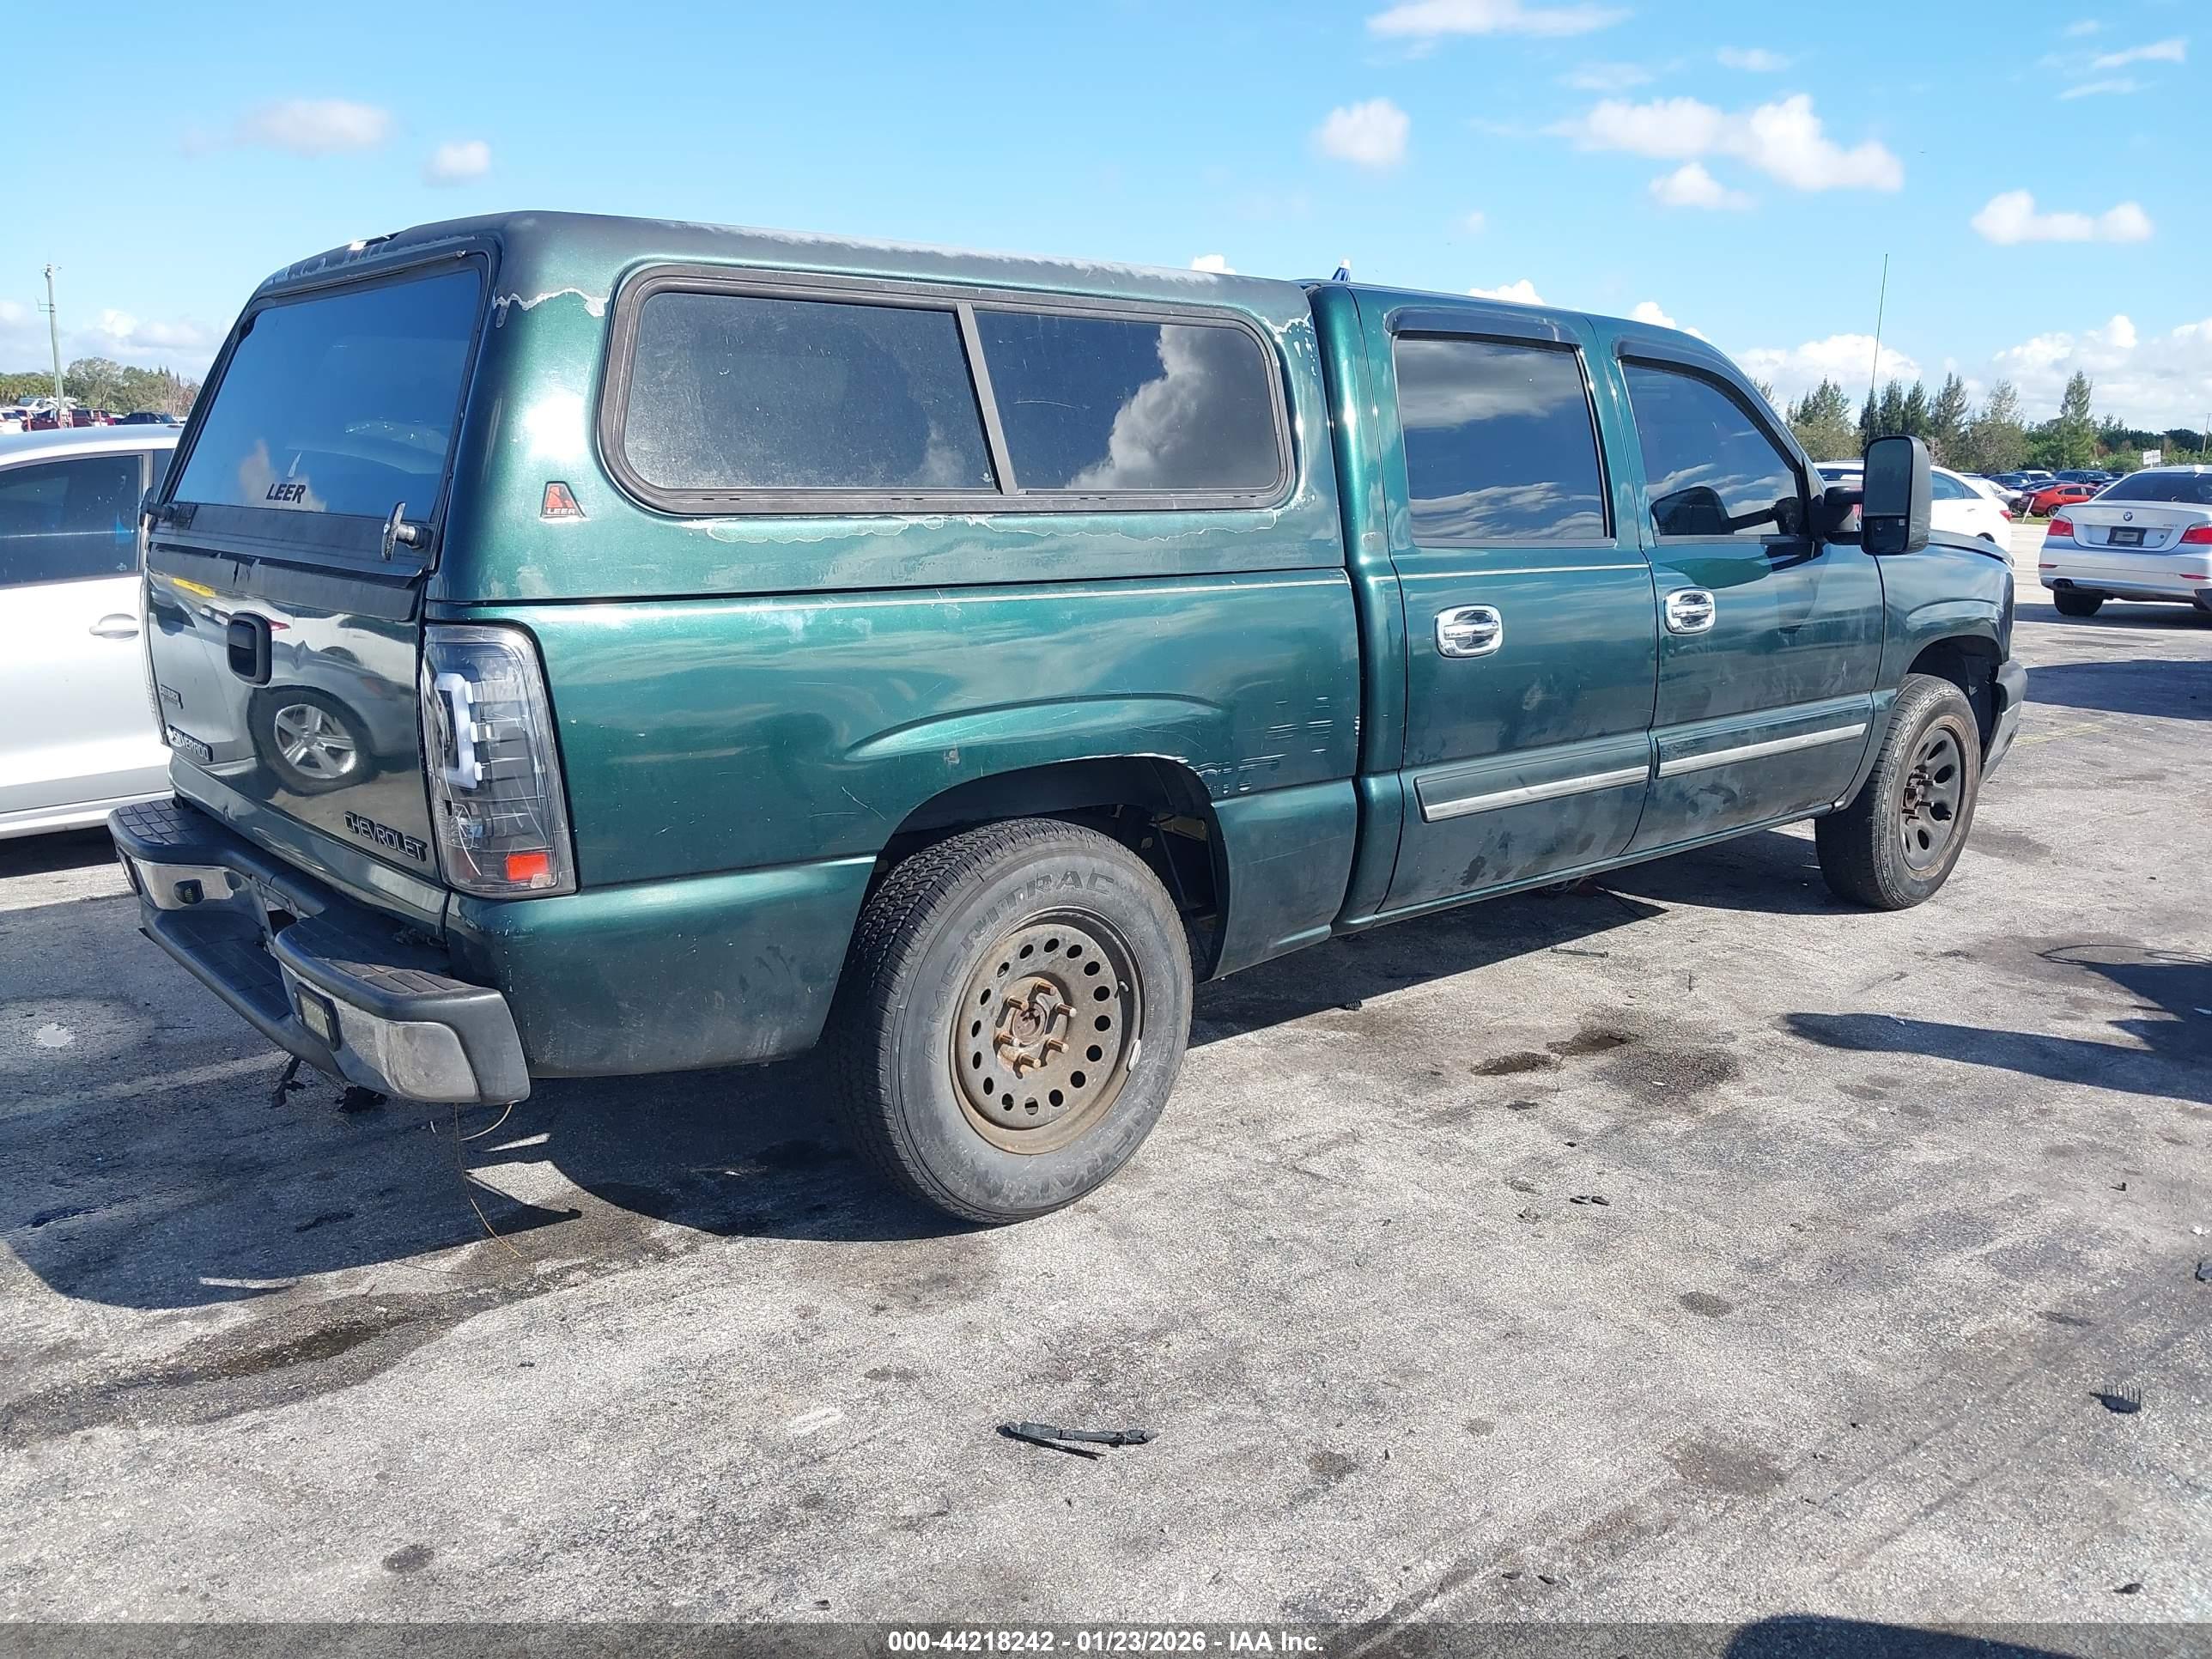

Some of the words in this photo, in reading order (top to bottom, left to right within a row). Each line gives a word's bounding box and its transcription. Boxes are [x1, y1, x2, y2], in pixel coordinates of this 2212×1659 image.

[266, 483, 306, 504] LEER
[343, 811, 426, 861] CHEVROLET
[922, 867, 1115, 1065] AMERITRAC
